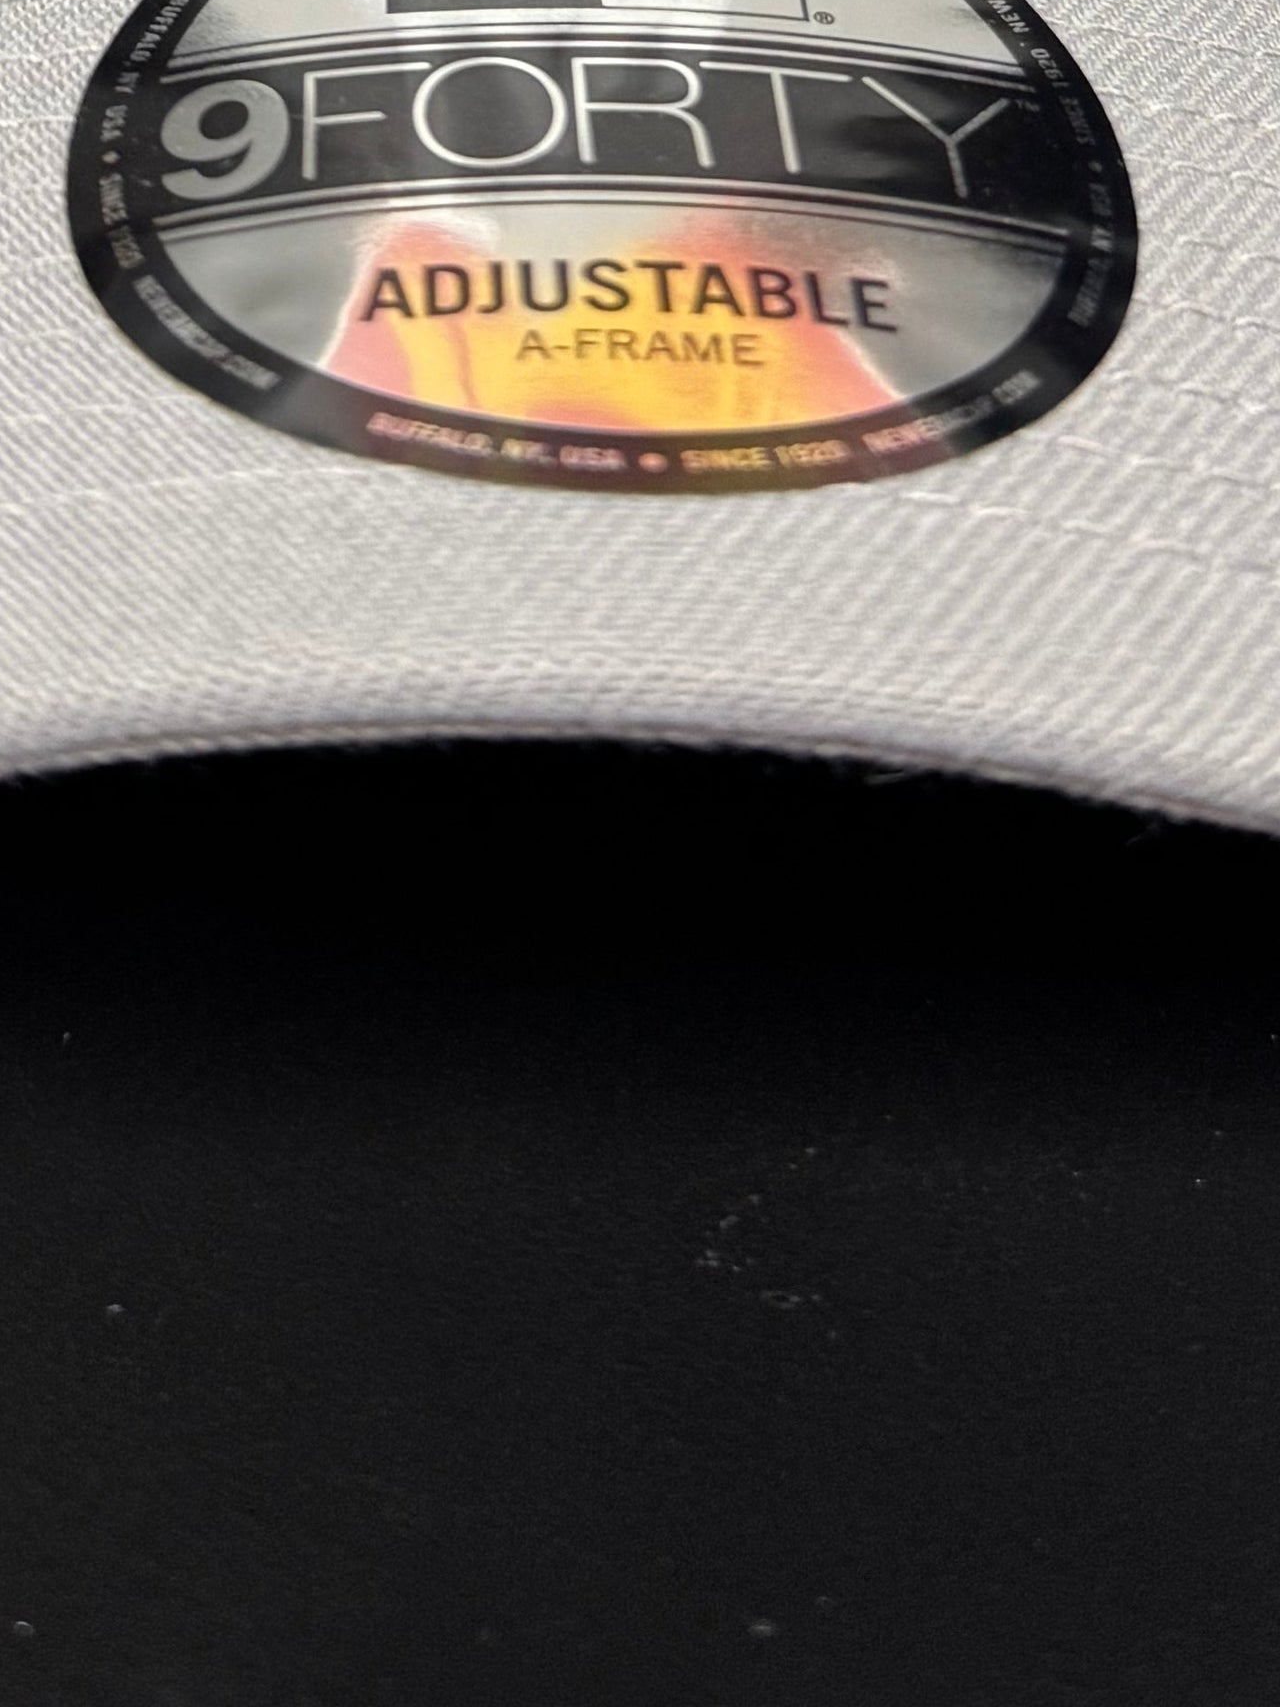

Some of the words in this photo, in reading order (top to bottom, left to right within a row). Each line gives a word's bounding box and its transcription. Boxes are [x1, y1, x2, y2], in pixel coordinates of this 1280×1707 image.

[159, 54, 1012, 200] 9FORTY
[360, 258, 900, 334] ADJUSTABLE
[515, 327, 765, 367] A-FRAME
